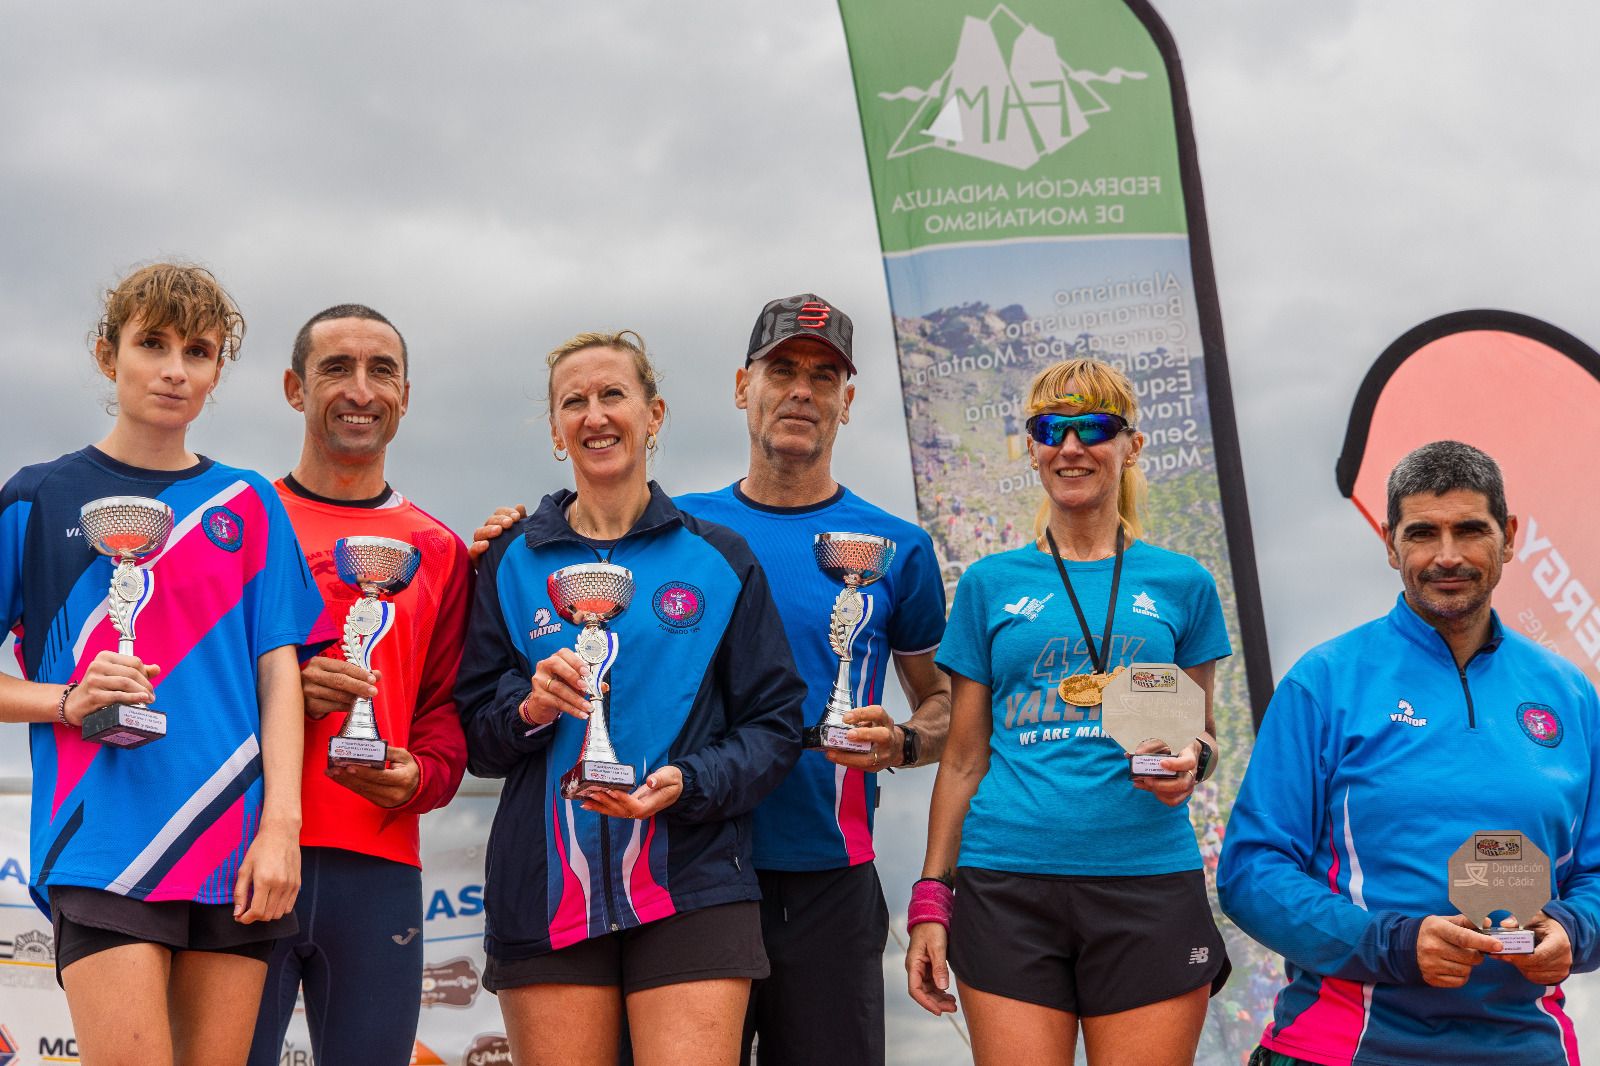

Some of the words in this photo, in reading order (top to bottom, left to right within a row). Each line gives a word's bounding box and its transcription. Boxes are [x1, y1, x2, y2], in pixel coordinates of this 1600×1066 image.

[66, 527, 84, 537] VI
[529, 623, 562, 640] VIATOR
[1033, 635, 1146, 684] 42K
[1389, 713, 1428, 727] VIATOR
[1019, 730, 1037, 746] WE
[1042, 727, 1070, 742] ARE
[1492, 862, 1544, 875] Diputación
[1493, 877, 1505, 887] de
[1508, 876, 1535, 888] Cádiz
